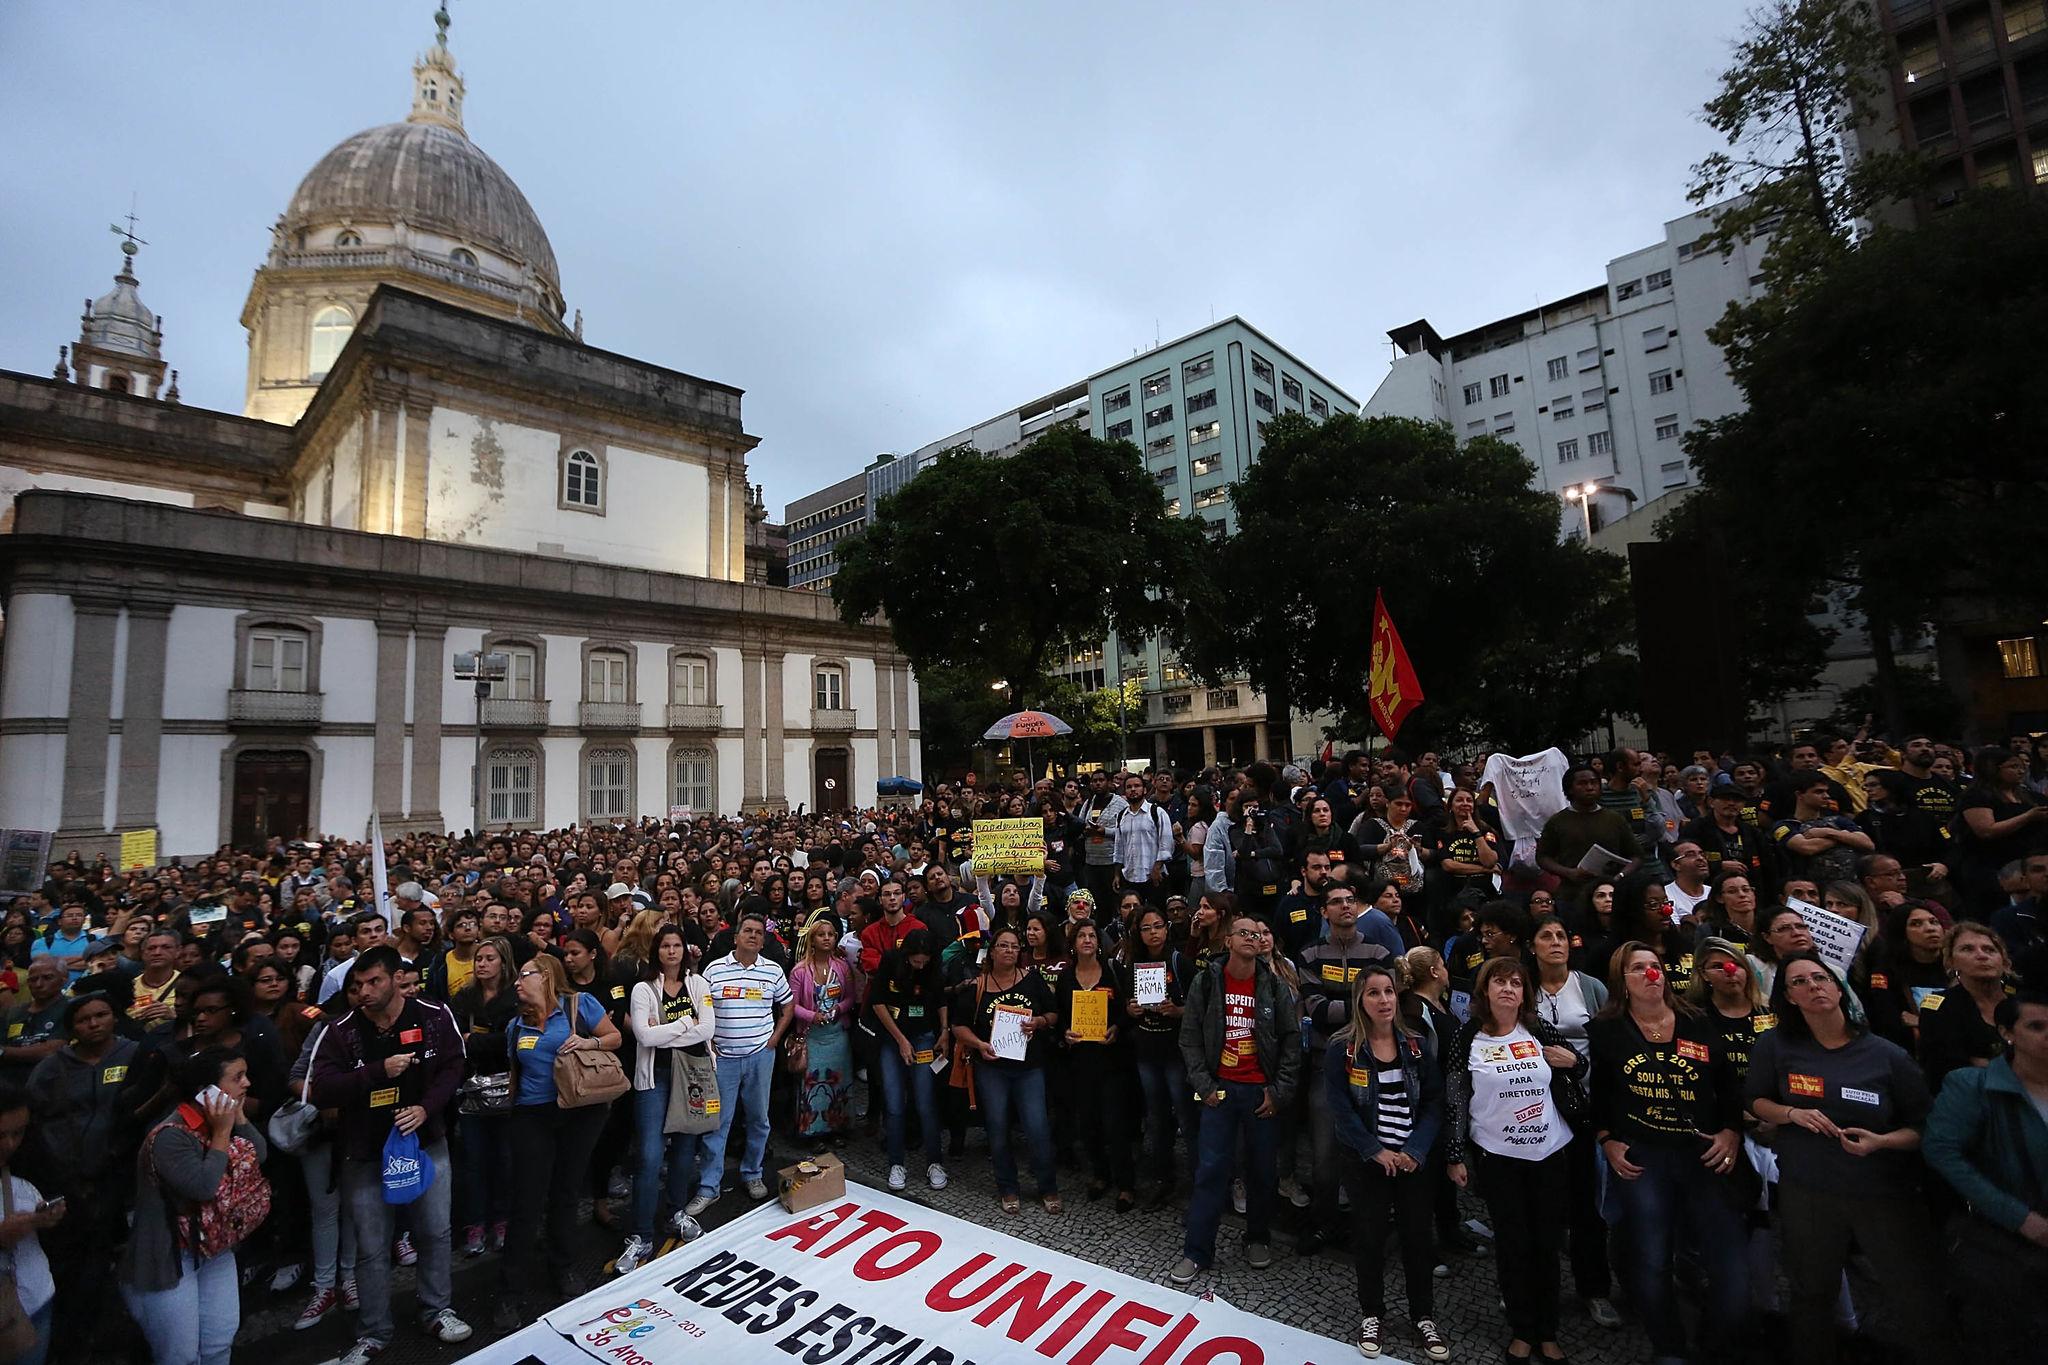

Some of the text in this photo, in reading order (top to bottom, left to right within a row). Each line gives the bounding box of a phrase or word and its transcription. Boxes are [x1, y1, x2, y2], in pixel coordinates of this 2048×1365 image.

[1815, 911, 1849, 927] PODERIA
[1816, 929, 1836, 941] AULA
[1819, 920, 1831, 930] EM
[1831, 926, 1852, 938] SALA
[1828, 941, 1845, 953] QUE
[1138, 980, 1164, 997] ARMA
[662, 998, 682, 1012] REVE
[986, 993, 1011, 1014] GREVE
[1225, 993, 1256, 1008] ESPEIT
[667, 1011, 678, 1020] SOU
[1233, 1006, 1244, 1015] AO
[1514, 1047, 1537, 1056] GREVE
[1679, 1046, 1707, 1058] GREVE
[1495, 1061, 1539, 1074] ELEIÇÕES
[1623, 1051, 1665, 1075] GREE
[1669, 1053, 1700, 1082] 2013
[1509, 1075, 1533, 1086] PARA
[1636, 1071, 1684, 1086] SOU PTE
[1499, 1087, 1545, 1099] DIRETORES
[1655, 1086, 1696, 1102] HISRIA
[1791, 1081, 1822, 1093] GREVE
[1515, 1111, 1527, 1121] EU
[764, 1203, 942, 1281] ATO
[662, 1250, 819, 1335] REDES
[645, 1305, 674, 1320] 1977
[677, 1319, 707, 1339] 2013
[585, 1330, 619, 1348] 36
